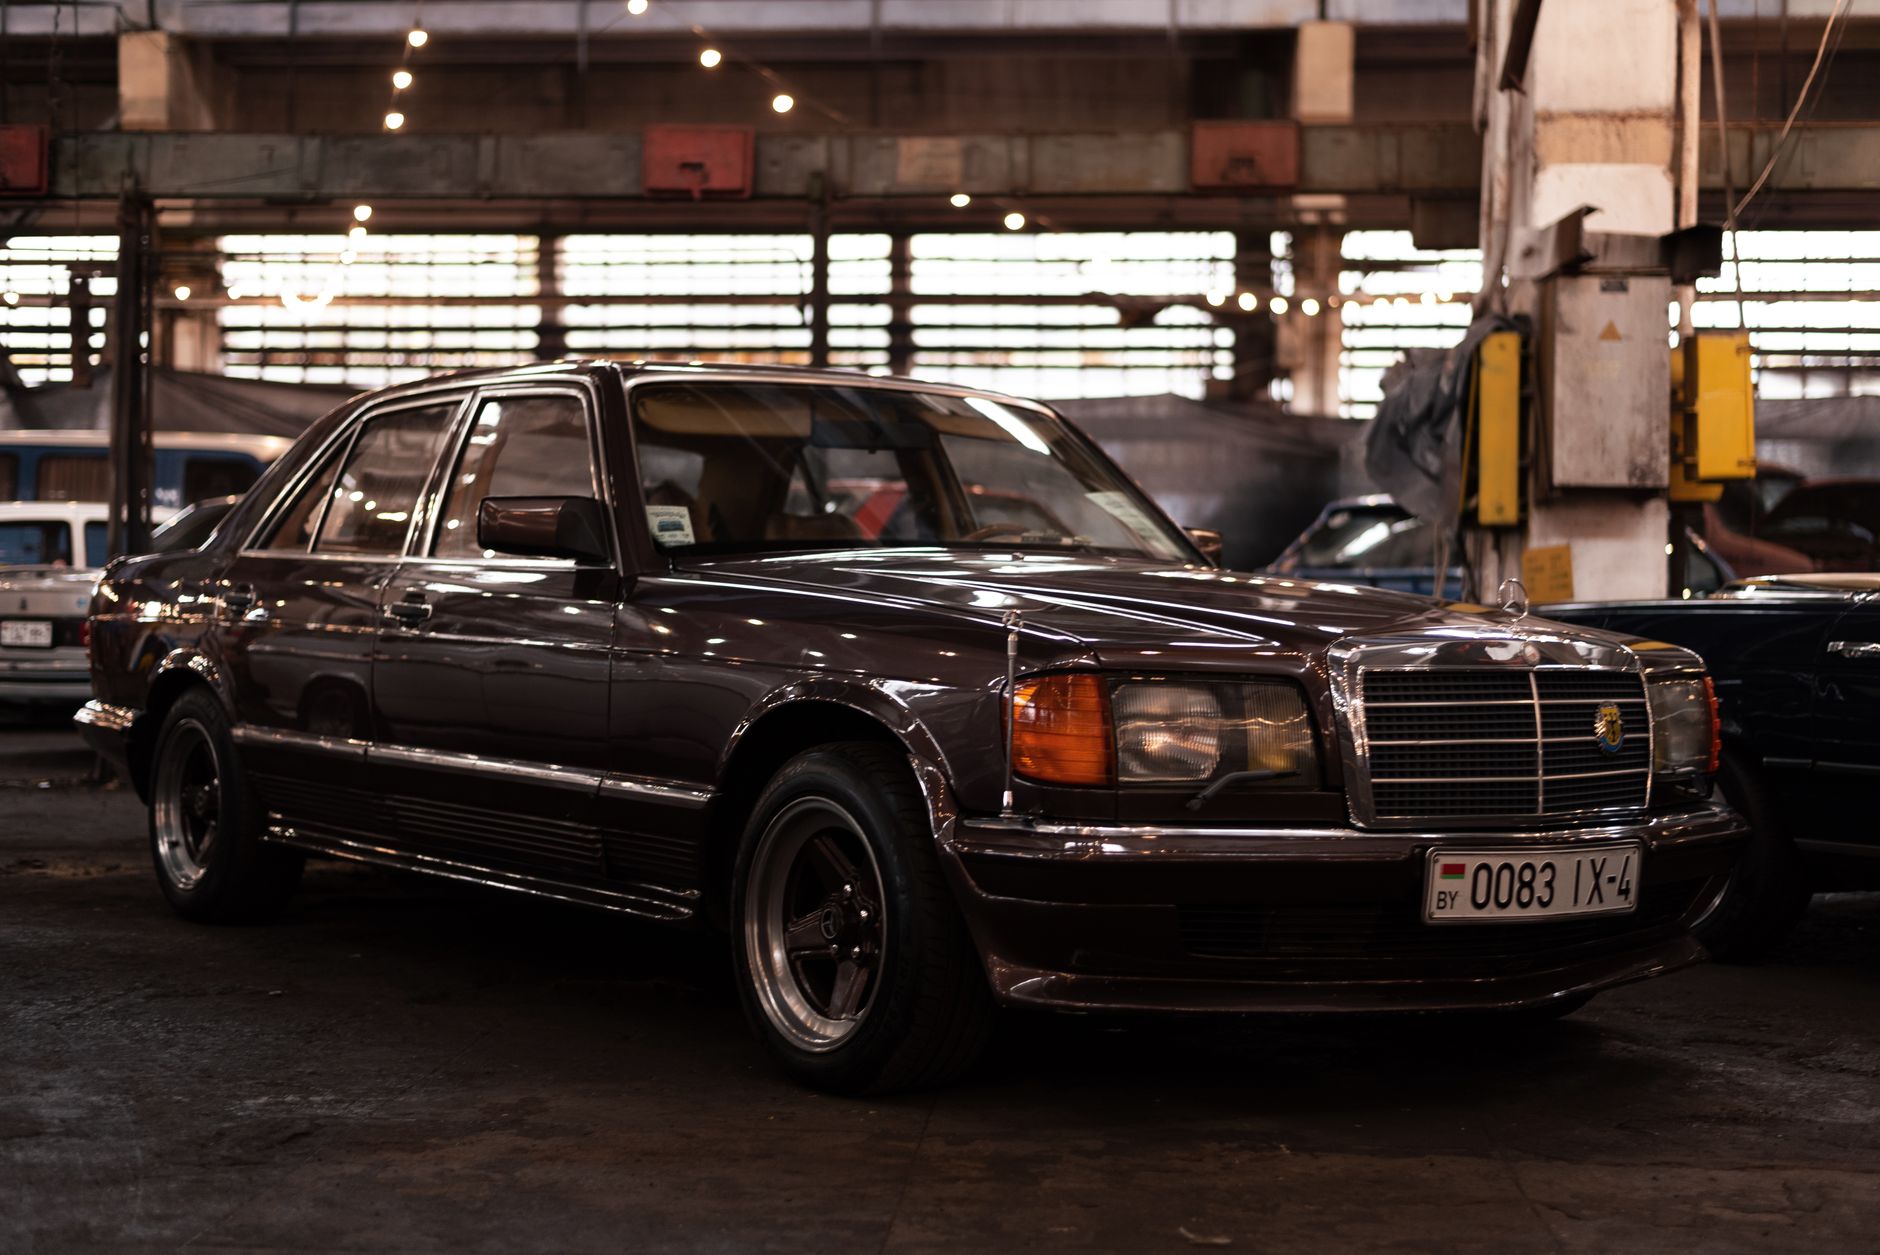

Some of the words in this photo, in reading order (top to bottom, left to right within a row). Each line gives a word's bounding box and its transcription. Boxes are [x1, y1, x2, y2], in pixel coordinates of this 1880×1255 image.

[1436, 890, 1458, 910] BY
[1471, 862, 1556, 910] 0083
[1572, 855, 1631, 907] IX-4
